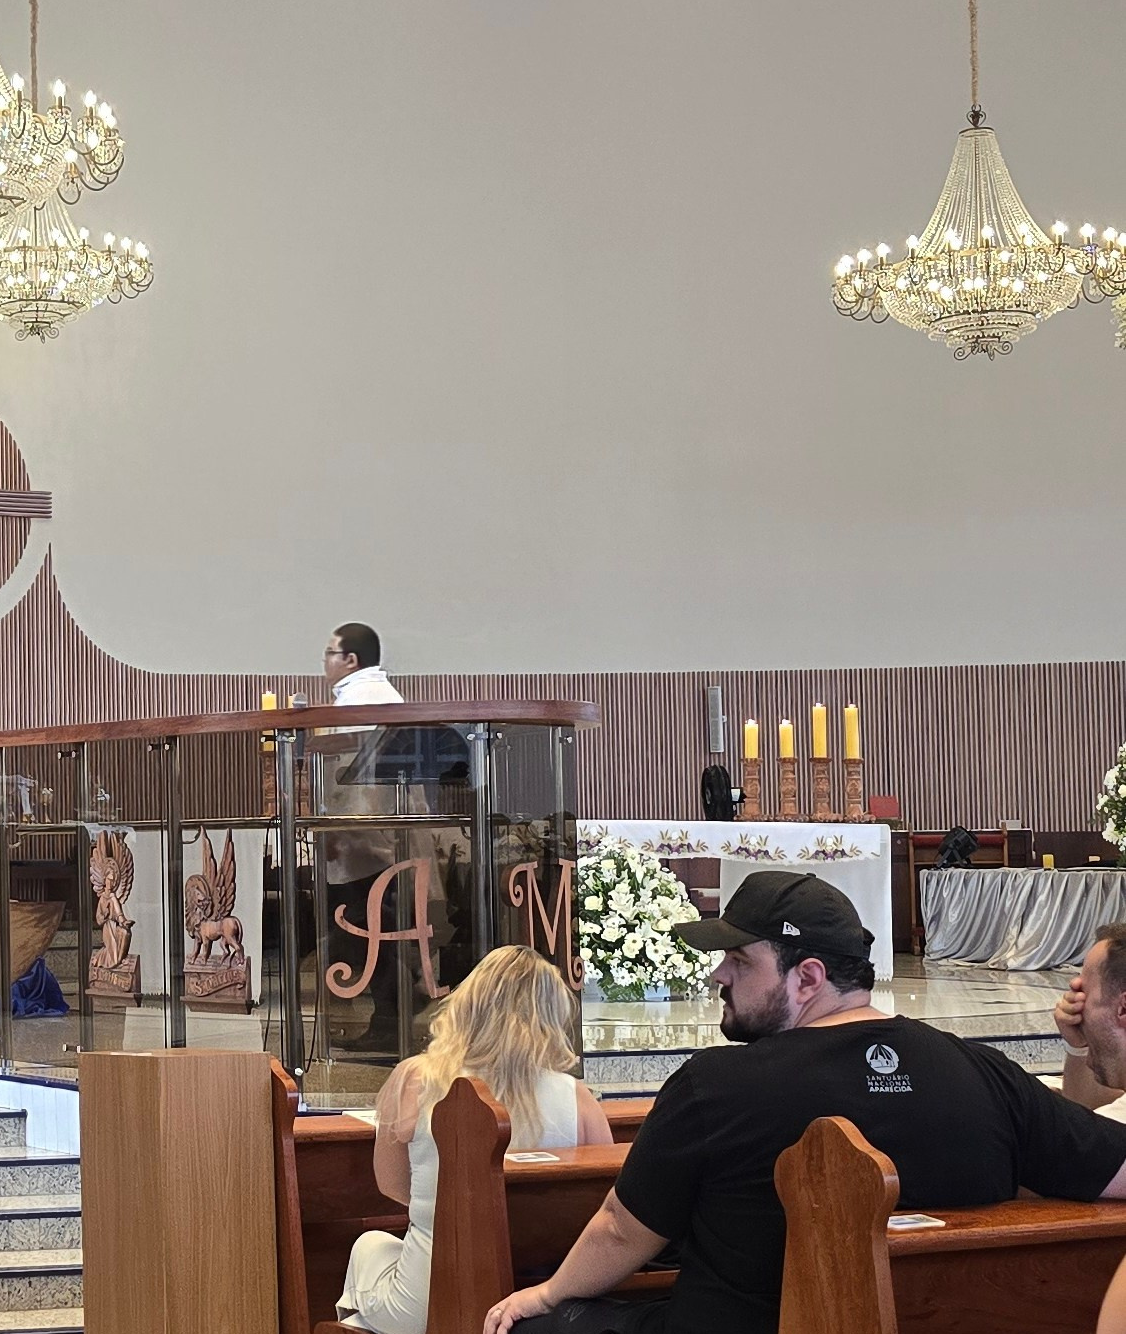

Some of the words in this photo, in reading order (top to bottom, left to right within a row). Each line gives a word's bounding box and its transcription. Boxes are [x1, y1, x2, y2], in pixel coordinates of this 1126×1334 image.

[326, 858, 450, 999] A
[509, 858, 585, 991] M
[869, 1085, 913, 1093] APARECIDA
